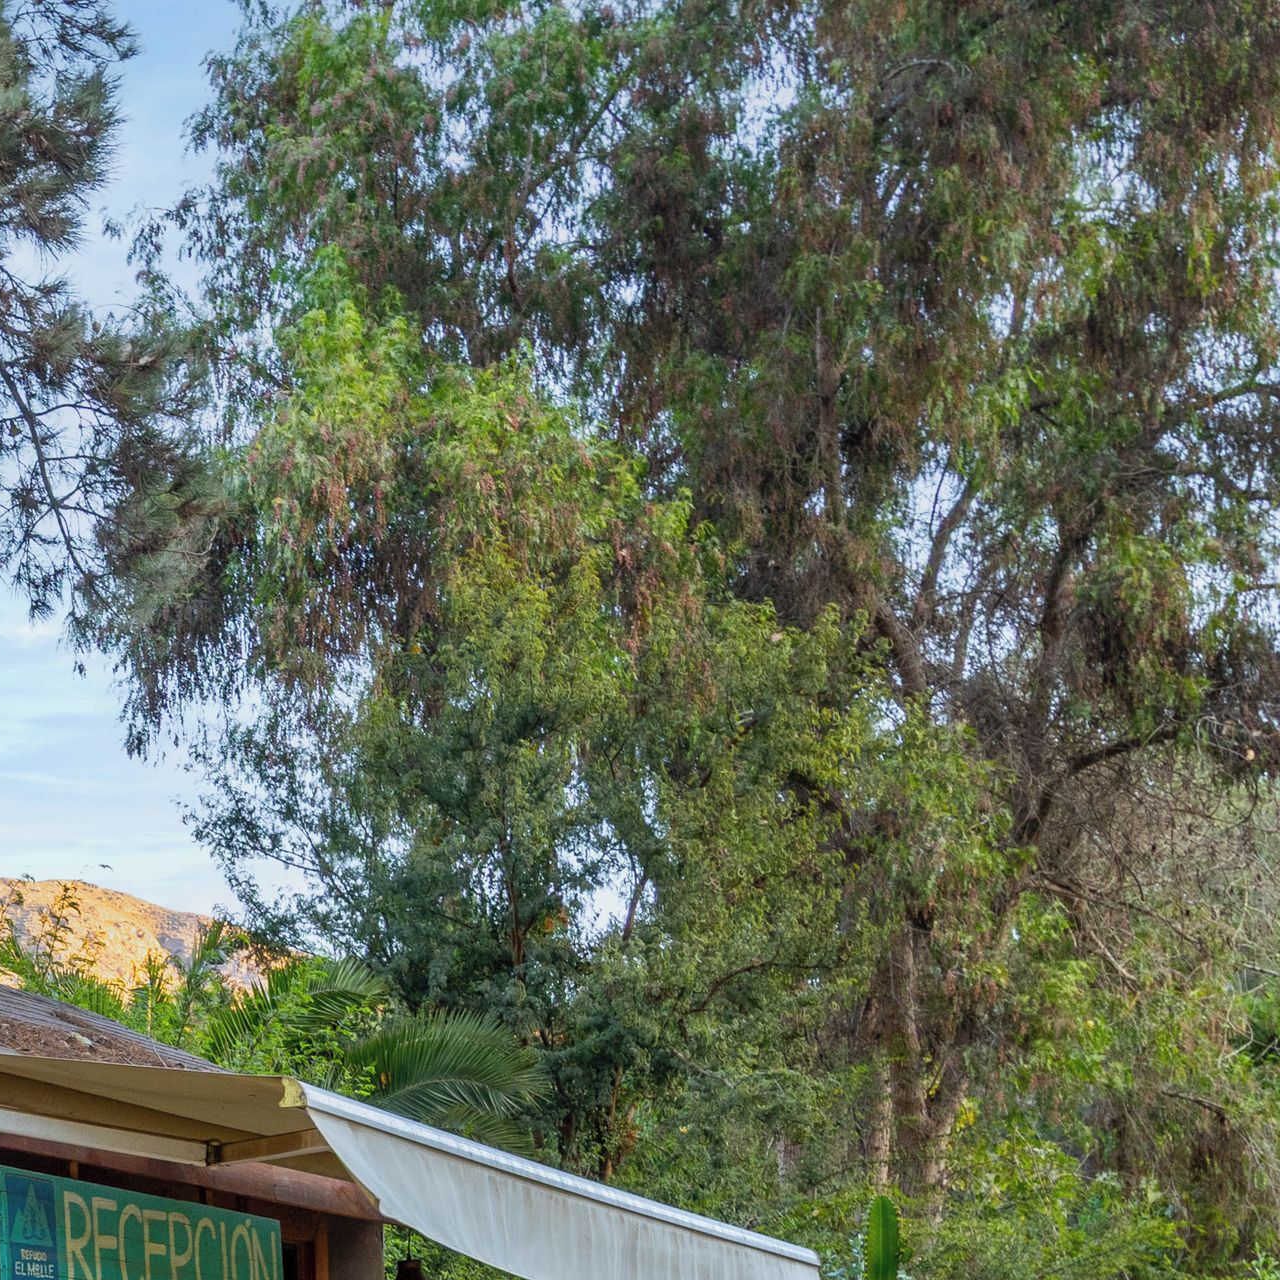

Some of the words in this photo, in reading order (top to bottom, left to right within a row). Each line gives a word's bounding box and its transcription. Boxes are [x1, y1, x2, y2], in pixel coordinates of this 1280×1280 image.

[20, 1248, 48, 1262] REFUGIO
[15, 1261, 27, 1276] EL
[27, 1262, 55, 1279] MOLLE
